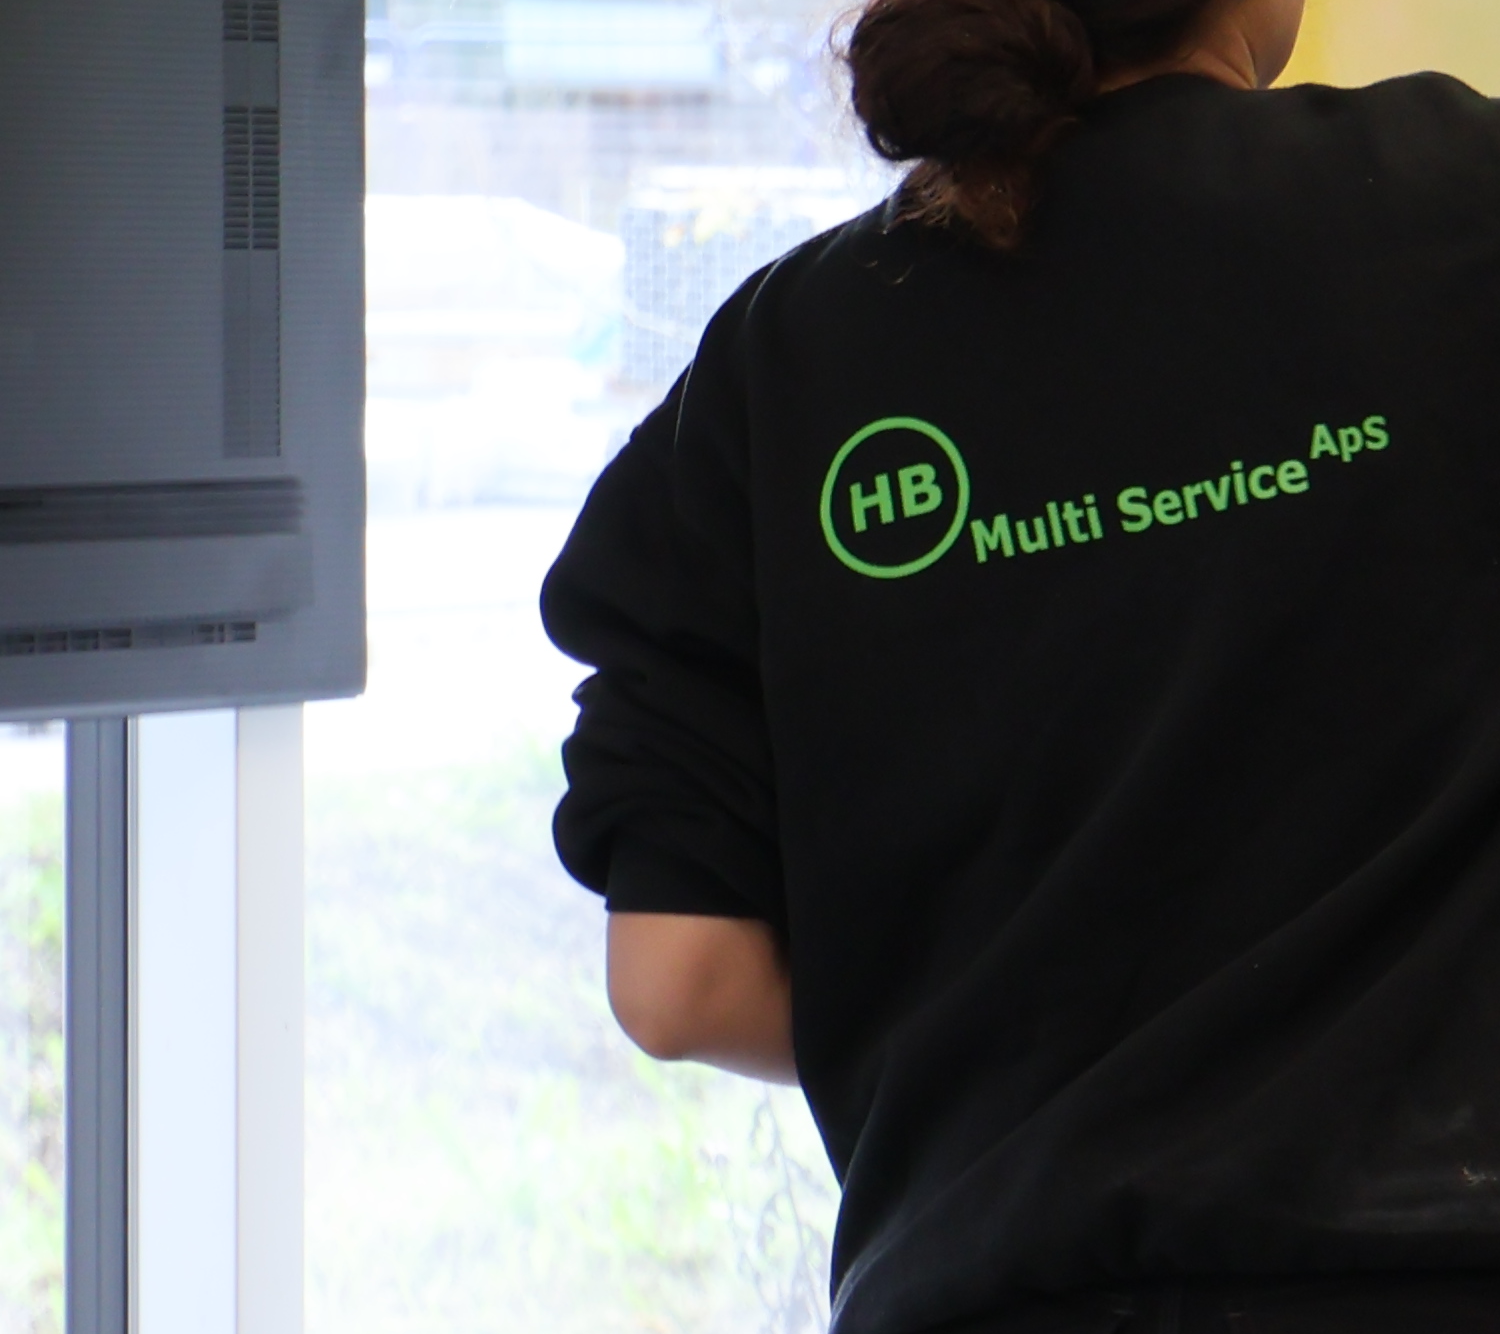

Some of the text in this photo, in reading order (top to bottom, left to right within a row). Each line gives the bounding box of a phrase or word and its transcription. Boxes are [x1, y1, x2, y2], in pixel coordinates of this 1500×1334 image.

[849, 462, 945, 533] HB
[970, 493, 1105, 563] Multi
[1117, 459, 1311, 533] Service
